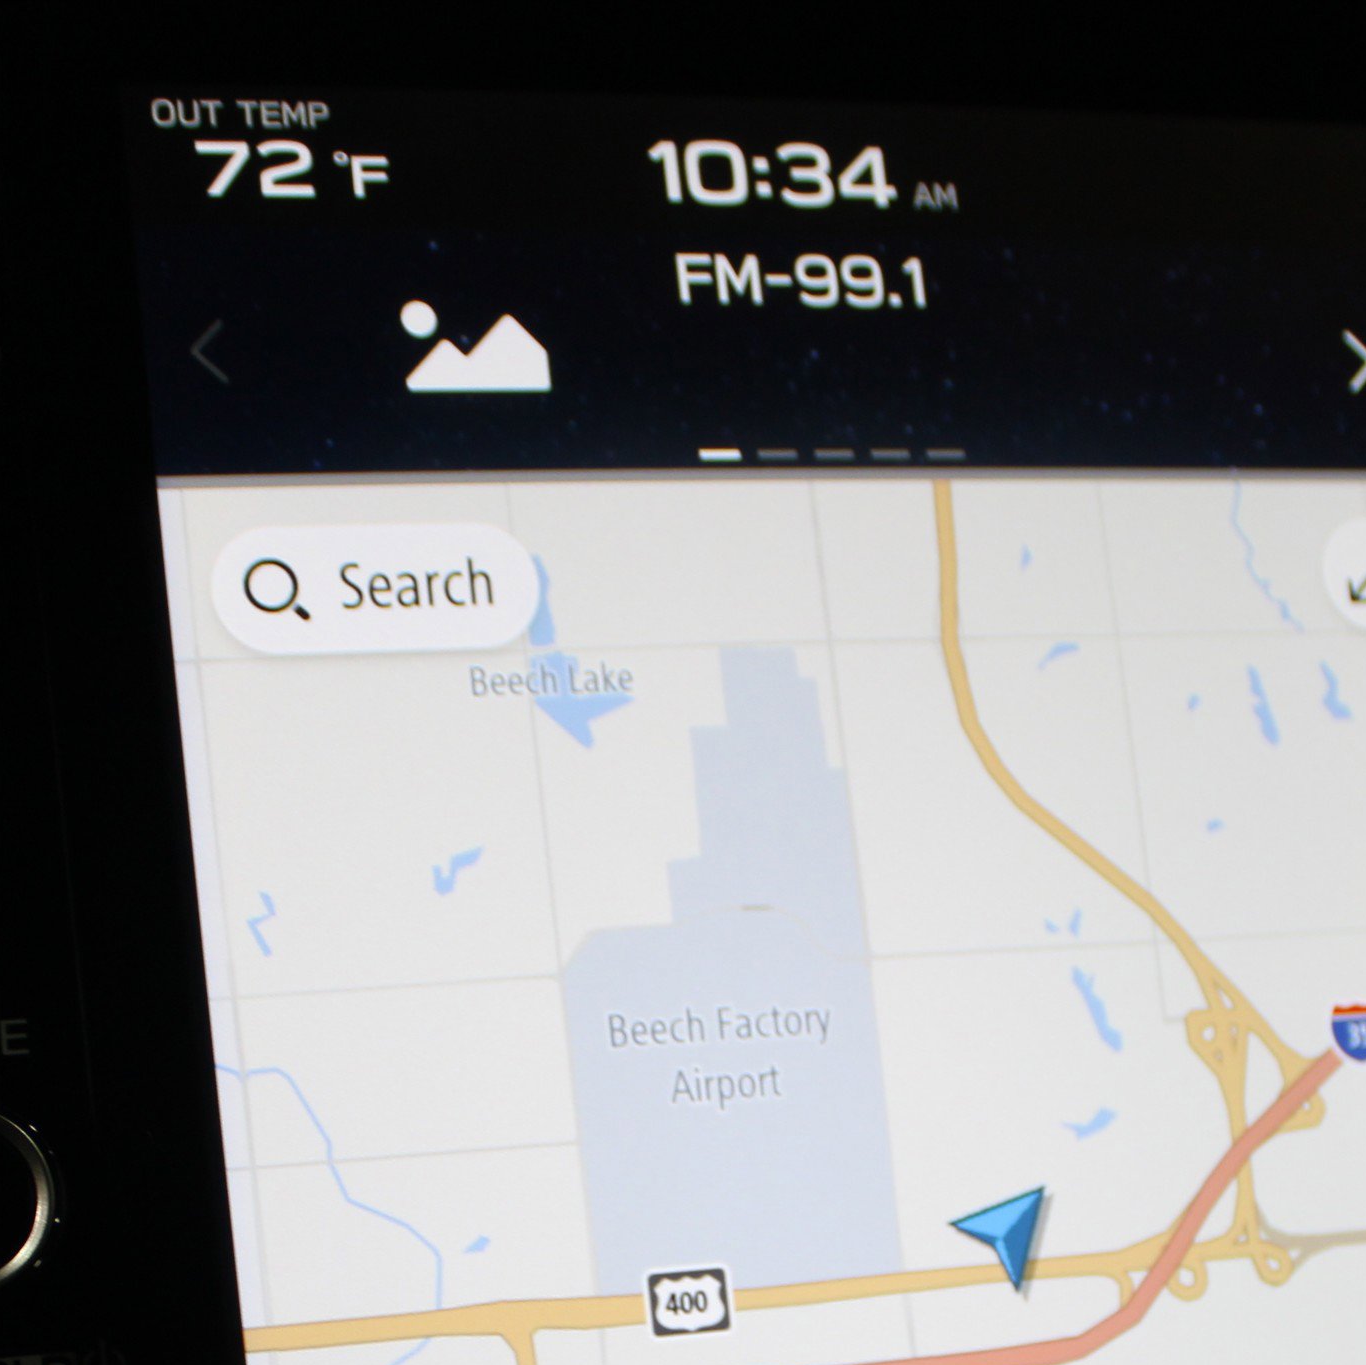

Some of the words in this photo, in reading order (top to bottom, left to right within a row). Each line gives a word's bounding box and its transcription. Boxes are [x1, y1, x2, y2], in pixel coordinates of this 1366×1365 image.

[150, 99, 222, 128] OUT
[236, 101, 330, 129] TEMP
[193, 140, 317, 198] 72
[648, 140, 898, 209] 10:34
[915, 181, 960, 211] AM
[675, 251, 929, 310] FM-99.1
[339, 558, 495, 610] Search
[470, 663, 559, 697] Beech
[567, 662, 635, 695] Lake
[608, 1008, 706, 1048] Beech
[716, 1004, 832, 1044] Factory
[671, 1066, 782, 1110] Airport
[665, 1290, 708, 1315] 400
